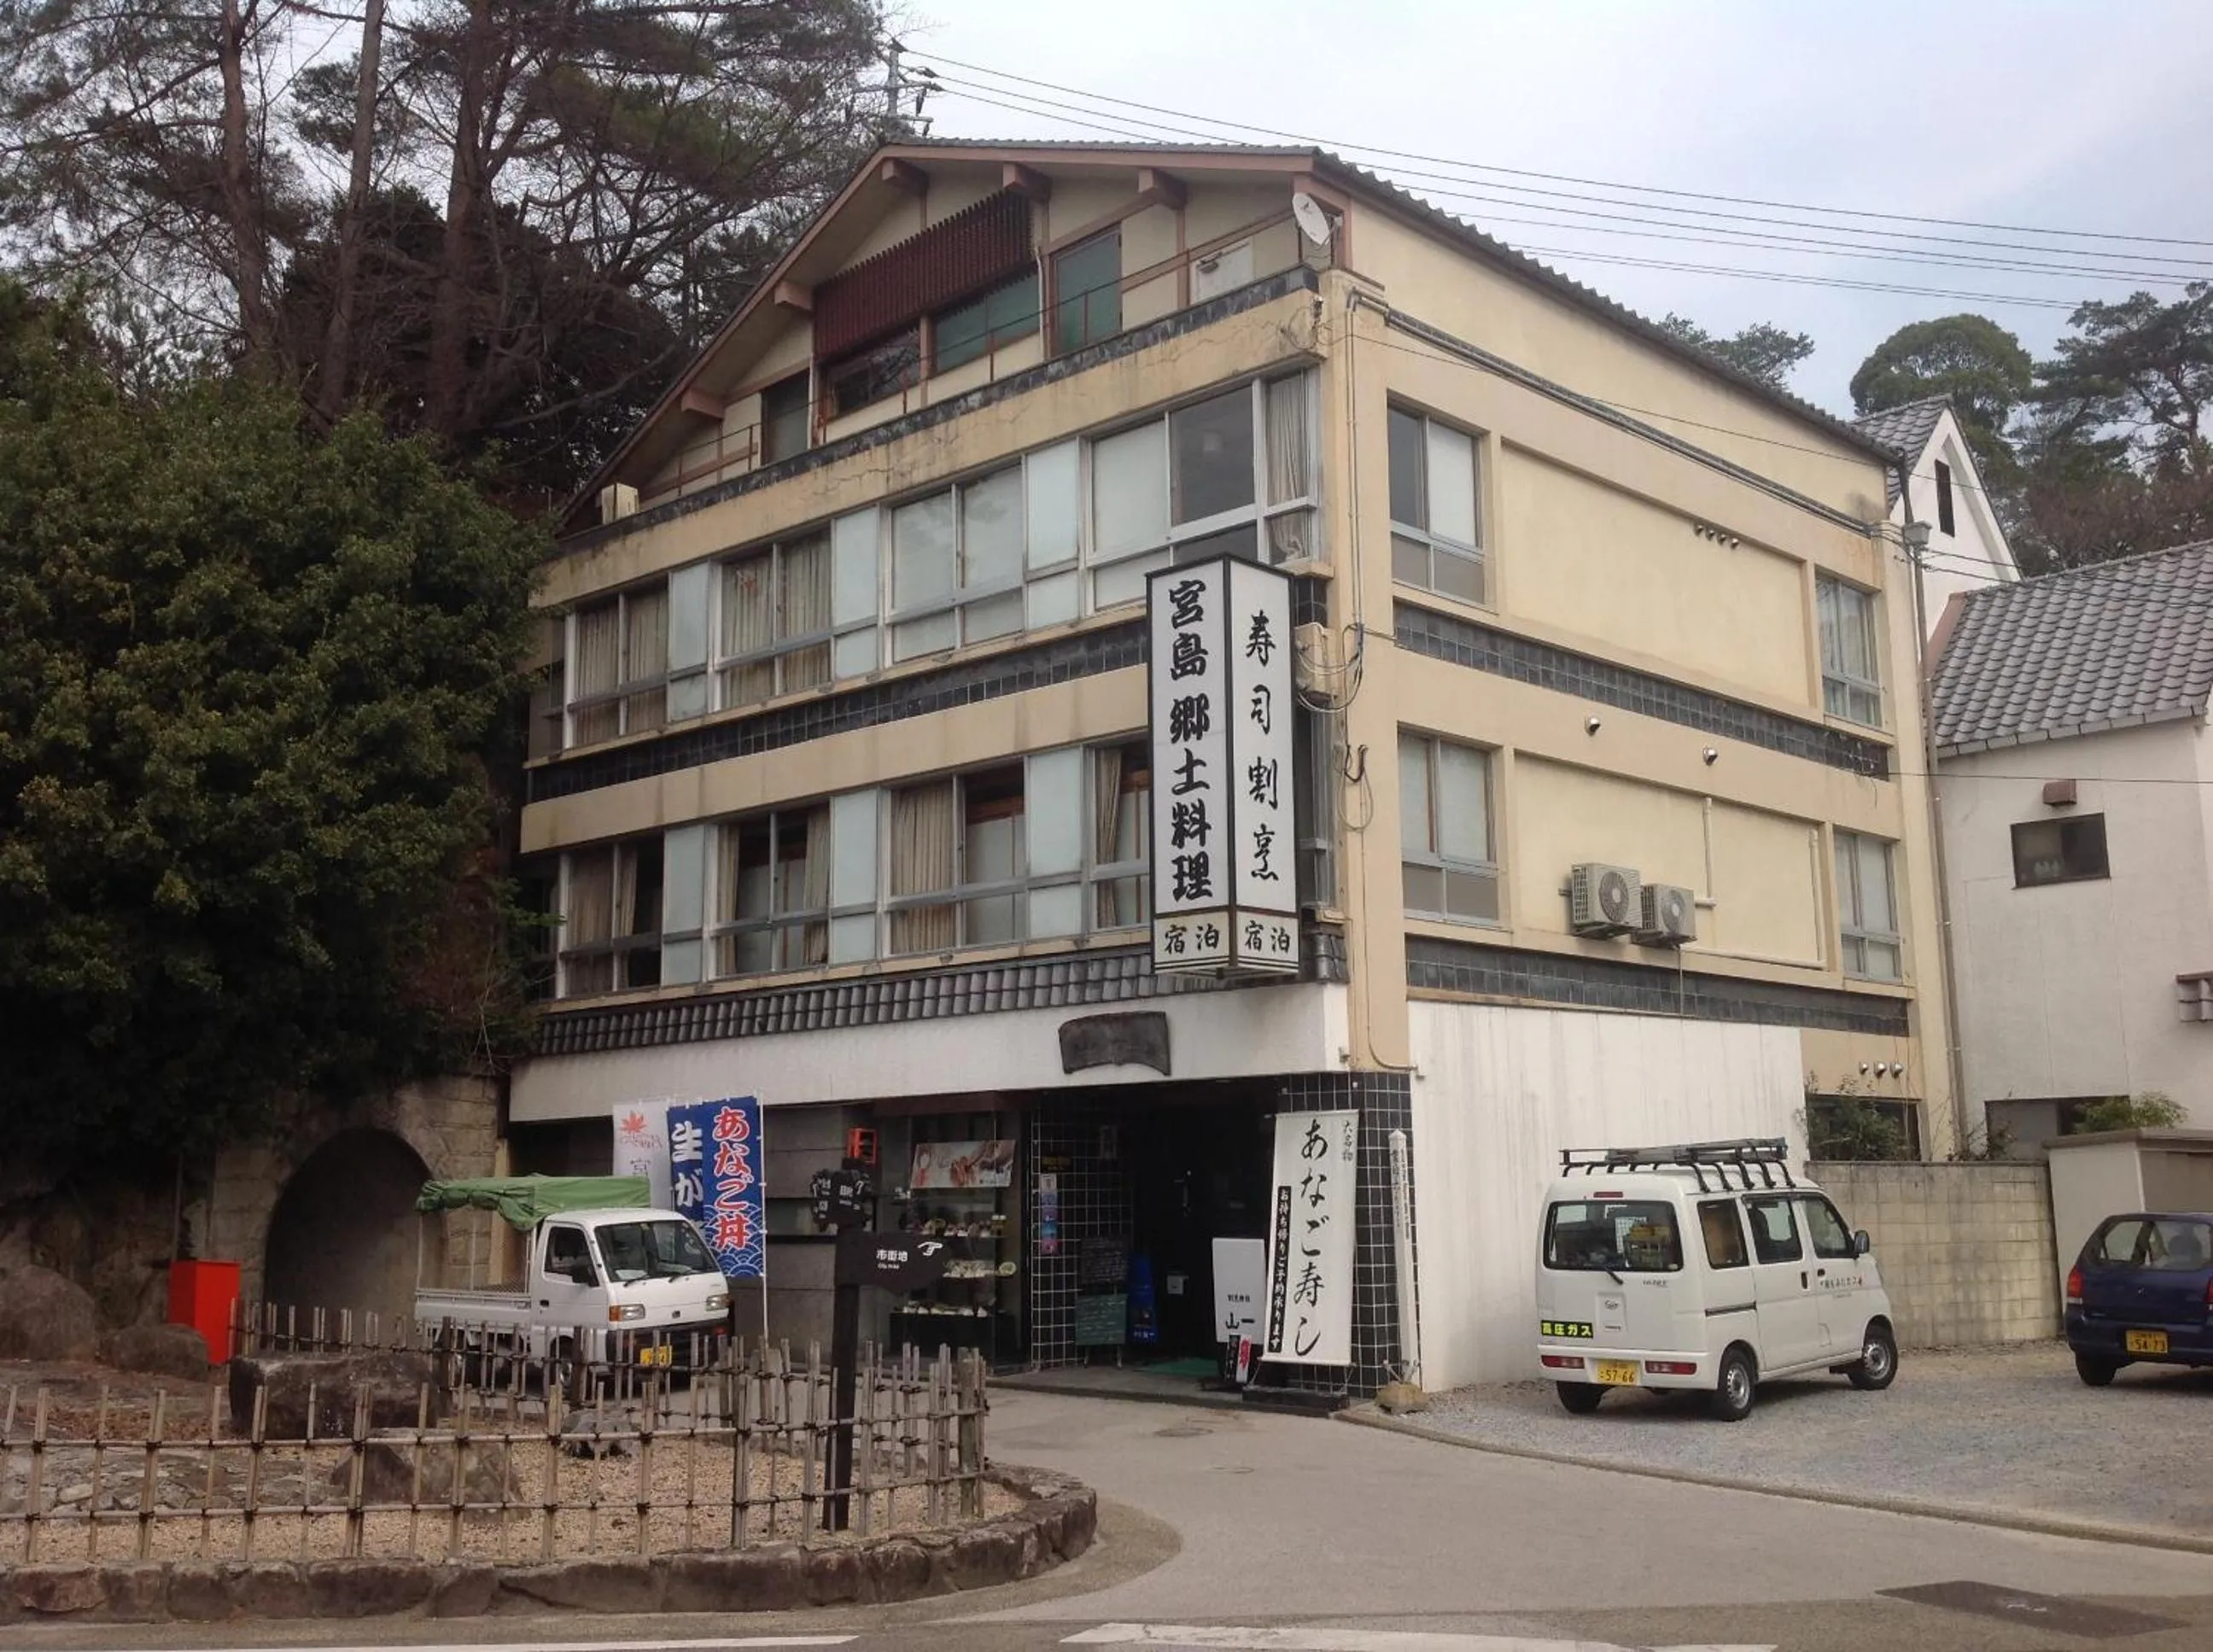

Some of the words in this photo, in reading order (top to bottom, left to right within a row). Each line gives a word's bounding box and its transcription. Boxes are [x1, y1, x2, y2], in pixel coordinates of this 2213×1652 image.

[1169, 579, 1213, 902] 宮島郷土料理
[1246, 609, 1279, 882] 寿司割烹
[1165, 917, 1220, 954] 宿泊
[1244, 919, 1291, 953] 宿泊
[671, 1120, 704, 1219] 生が
[712, 1106, 754, 1251] あなご丼
[876, 1249, 908, 1262] 市街地
[1293, 1118, 1329, 1357] あなご寿し
[1225, 1311, 1255, 1329] 山一
[1542, 1322, 1592, 1336] 高圧ガス
